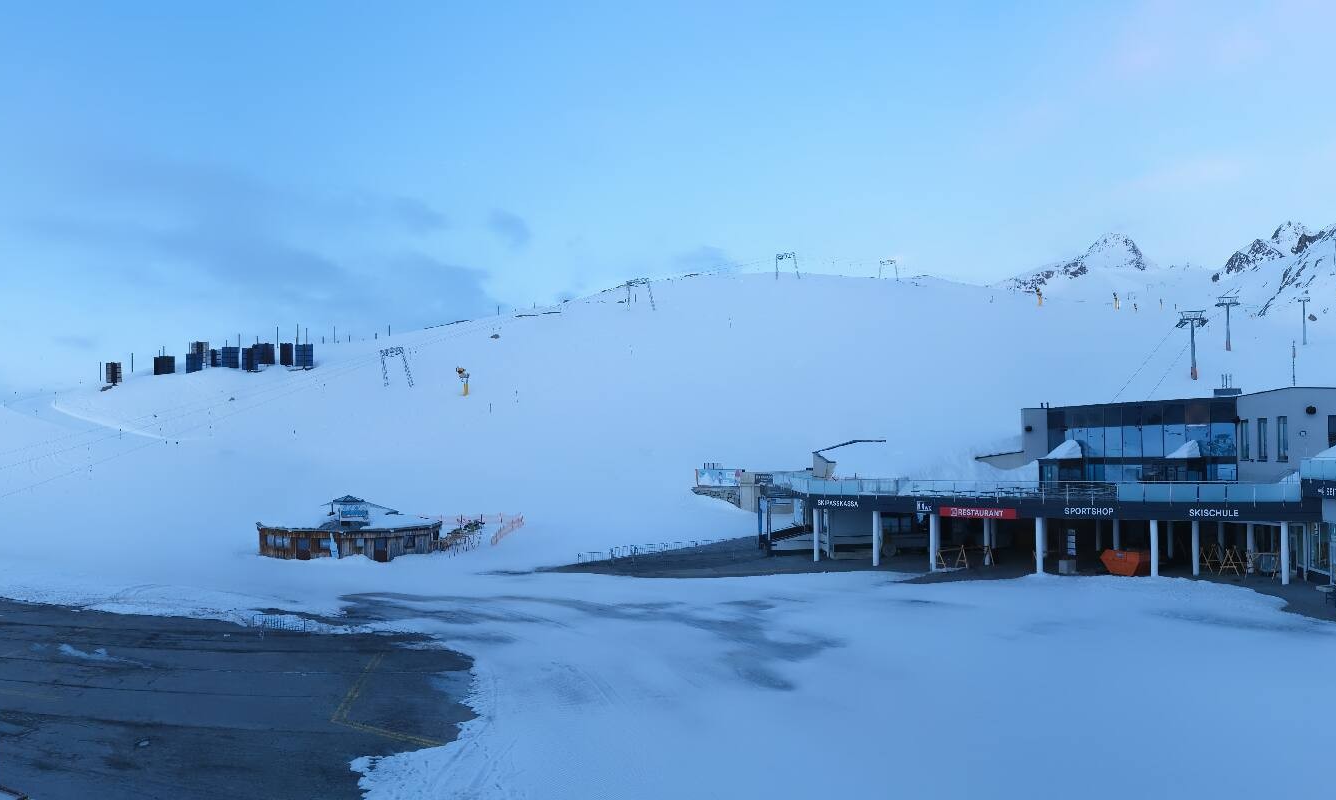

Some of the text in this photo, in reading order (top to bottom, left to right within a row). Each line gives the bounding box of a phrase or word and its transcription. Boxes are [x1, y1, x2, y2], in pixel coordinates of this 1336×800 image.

[957, 508, 1004, 517] RESTAURANT
[1064, 507, 1114, 516] SPORTSHOP
[1189, 508, 1240, 517] SKISCHULE
